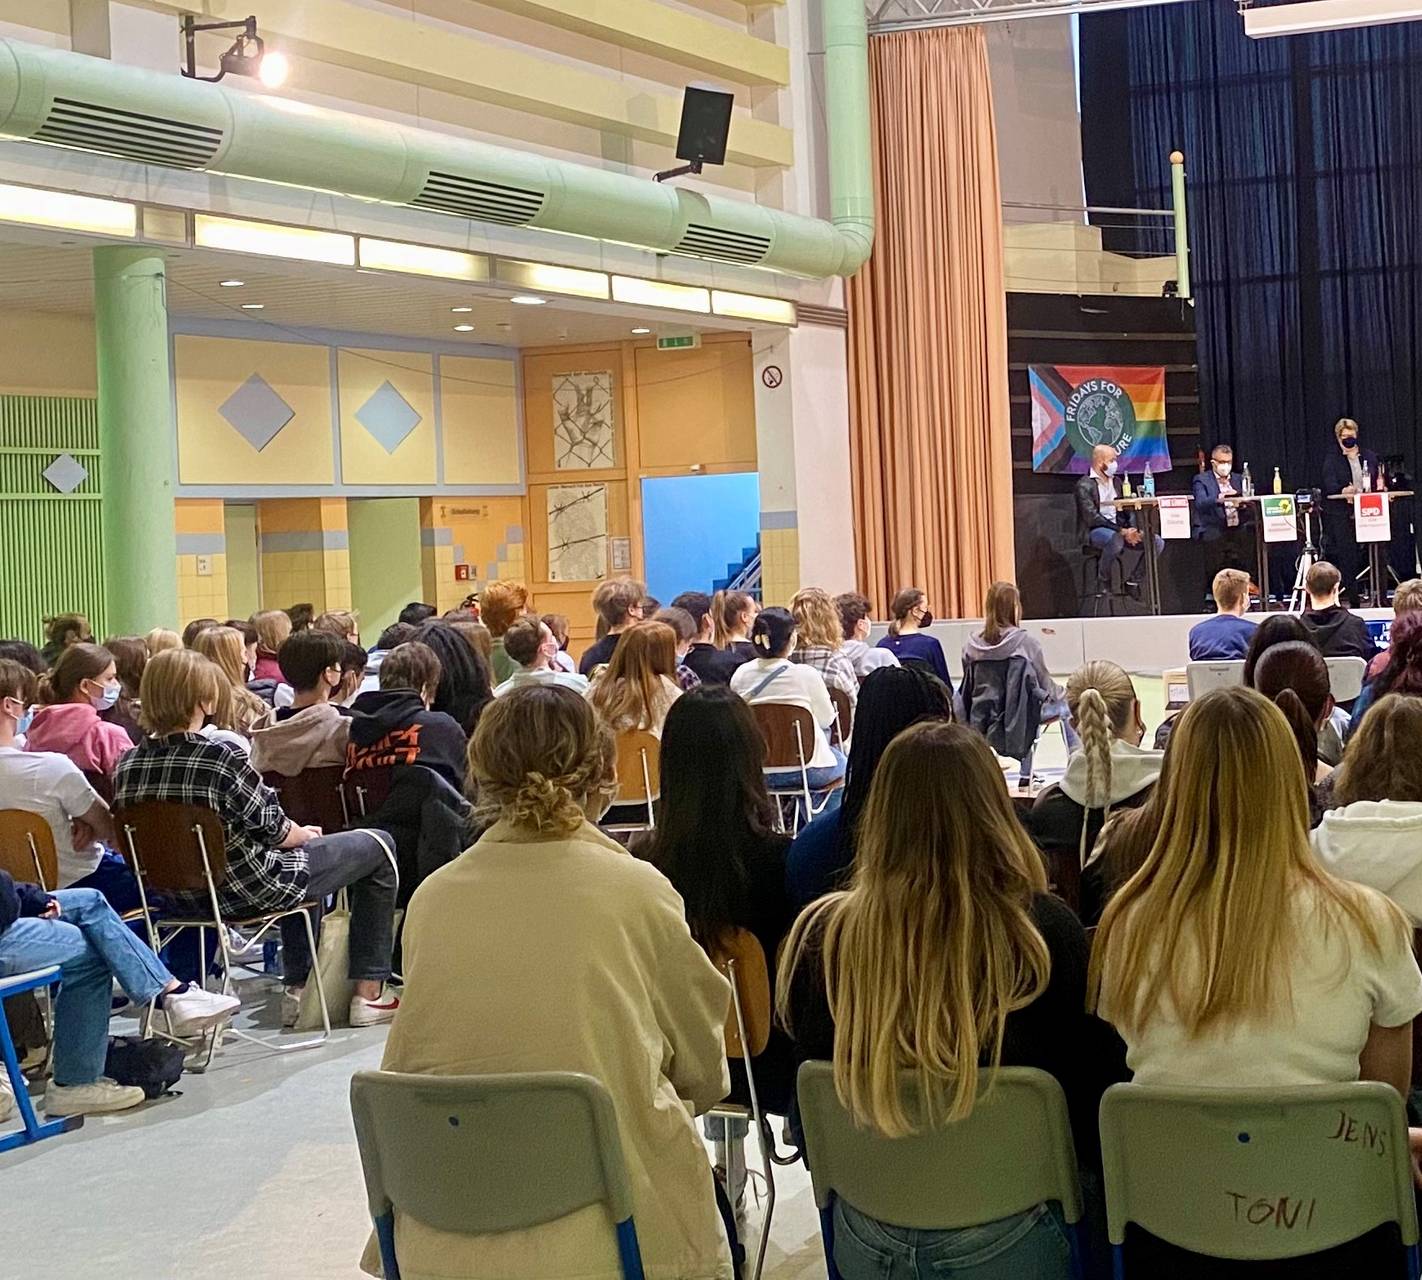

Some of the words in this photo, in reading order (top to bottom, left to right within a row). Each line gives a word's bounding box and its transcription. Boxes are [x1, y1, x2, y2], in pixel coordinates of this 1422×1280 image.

[1066, 380, 1098, 422] FRIDAYS
[1101, 380, 1123, 399] FOR
[1115, 432, 1133, 456] URE
[1361, 507, 1381, 516] SPD
[1328, 1110, 1387, 1156] JENS
[1225, 1191, 1316, 1231] TONI
